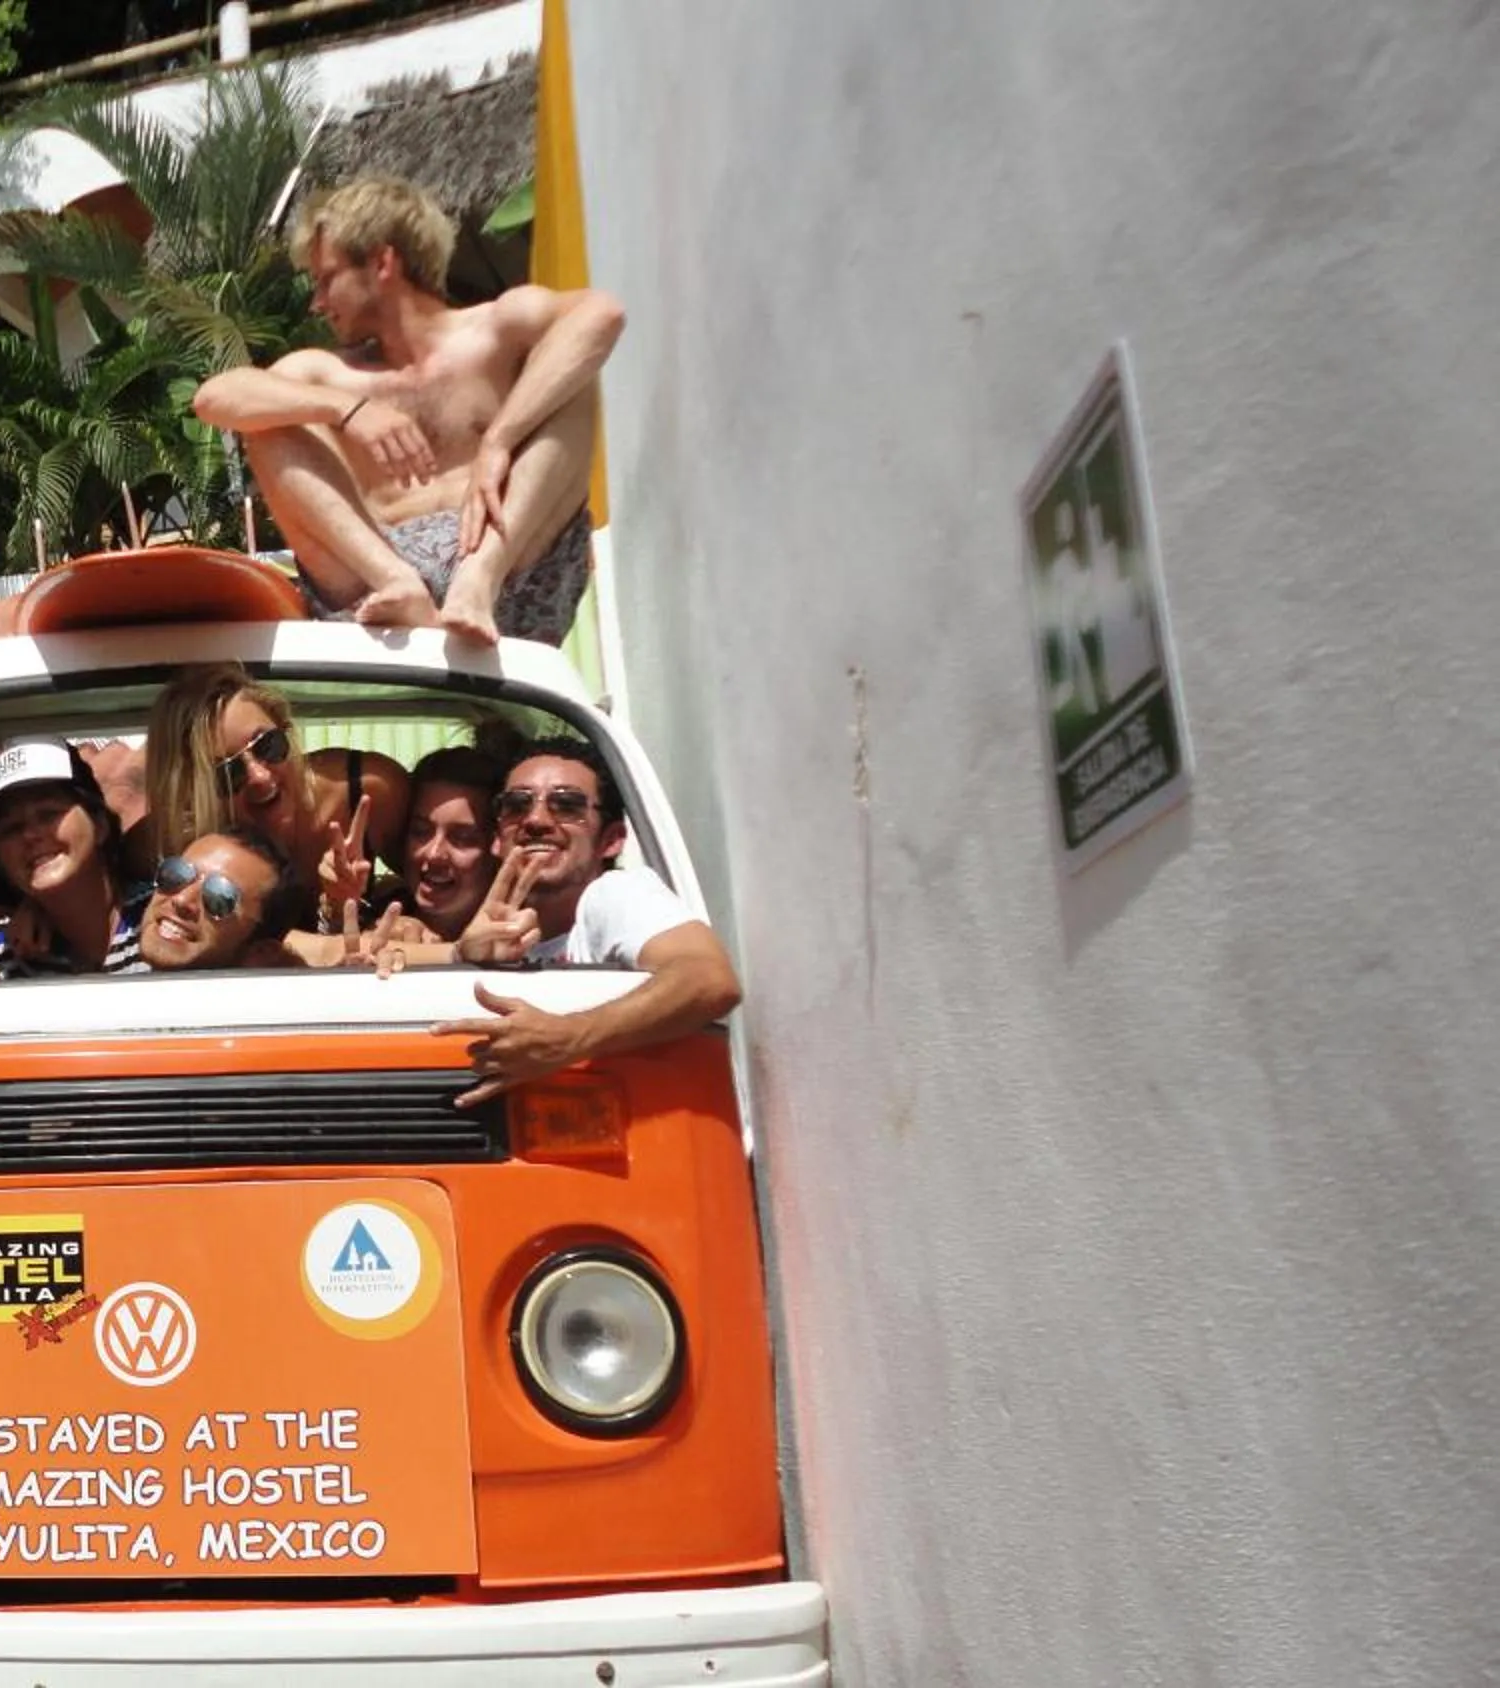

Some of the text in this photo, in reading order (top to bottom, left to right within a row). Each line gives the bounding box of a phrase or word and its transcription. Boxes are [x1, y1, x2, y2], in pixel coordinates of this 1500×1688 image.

[184, 1412, 248, 1450] AT
[264, 1409, 358, 1449] THE
[183, 1464, 367, 1505] HOSTEL
[199, 1520, 385, 1561] MEXICO
